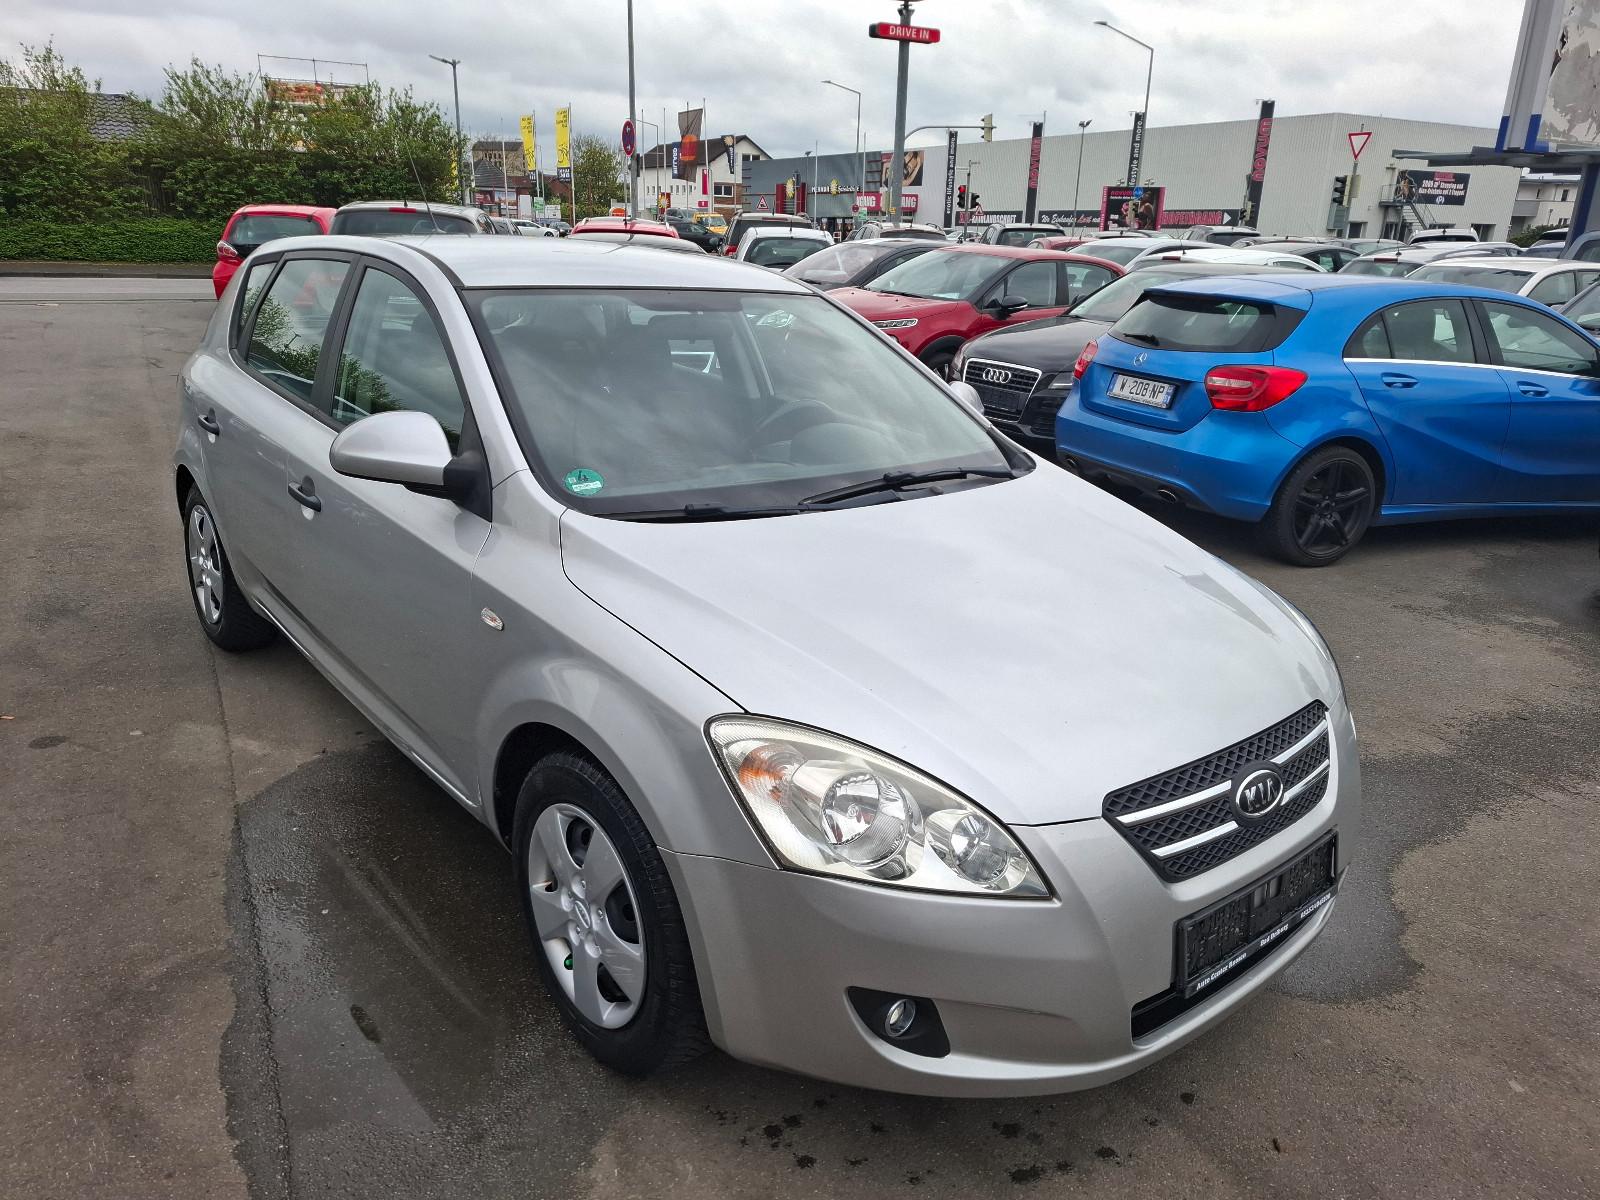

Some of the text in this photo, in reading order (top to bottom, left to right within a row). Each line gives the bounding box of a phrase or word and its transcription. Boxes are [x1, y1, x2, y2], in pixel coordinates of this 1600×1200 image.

[889, 25, 930, 40] DRIVE IN
[1252, 117, 1273, 182] novum
[1243, 777, 1278, 812] KIA
[1196, 977, 1210, 991] Auto
